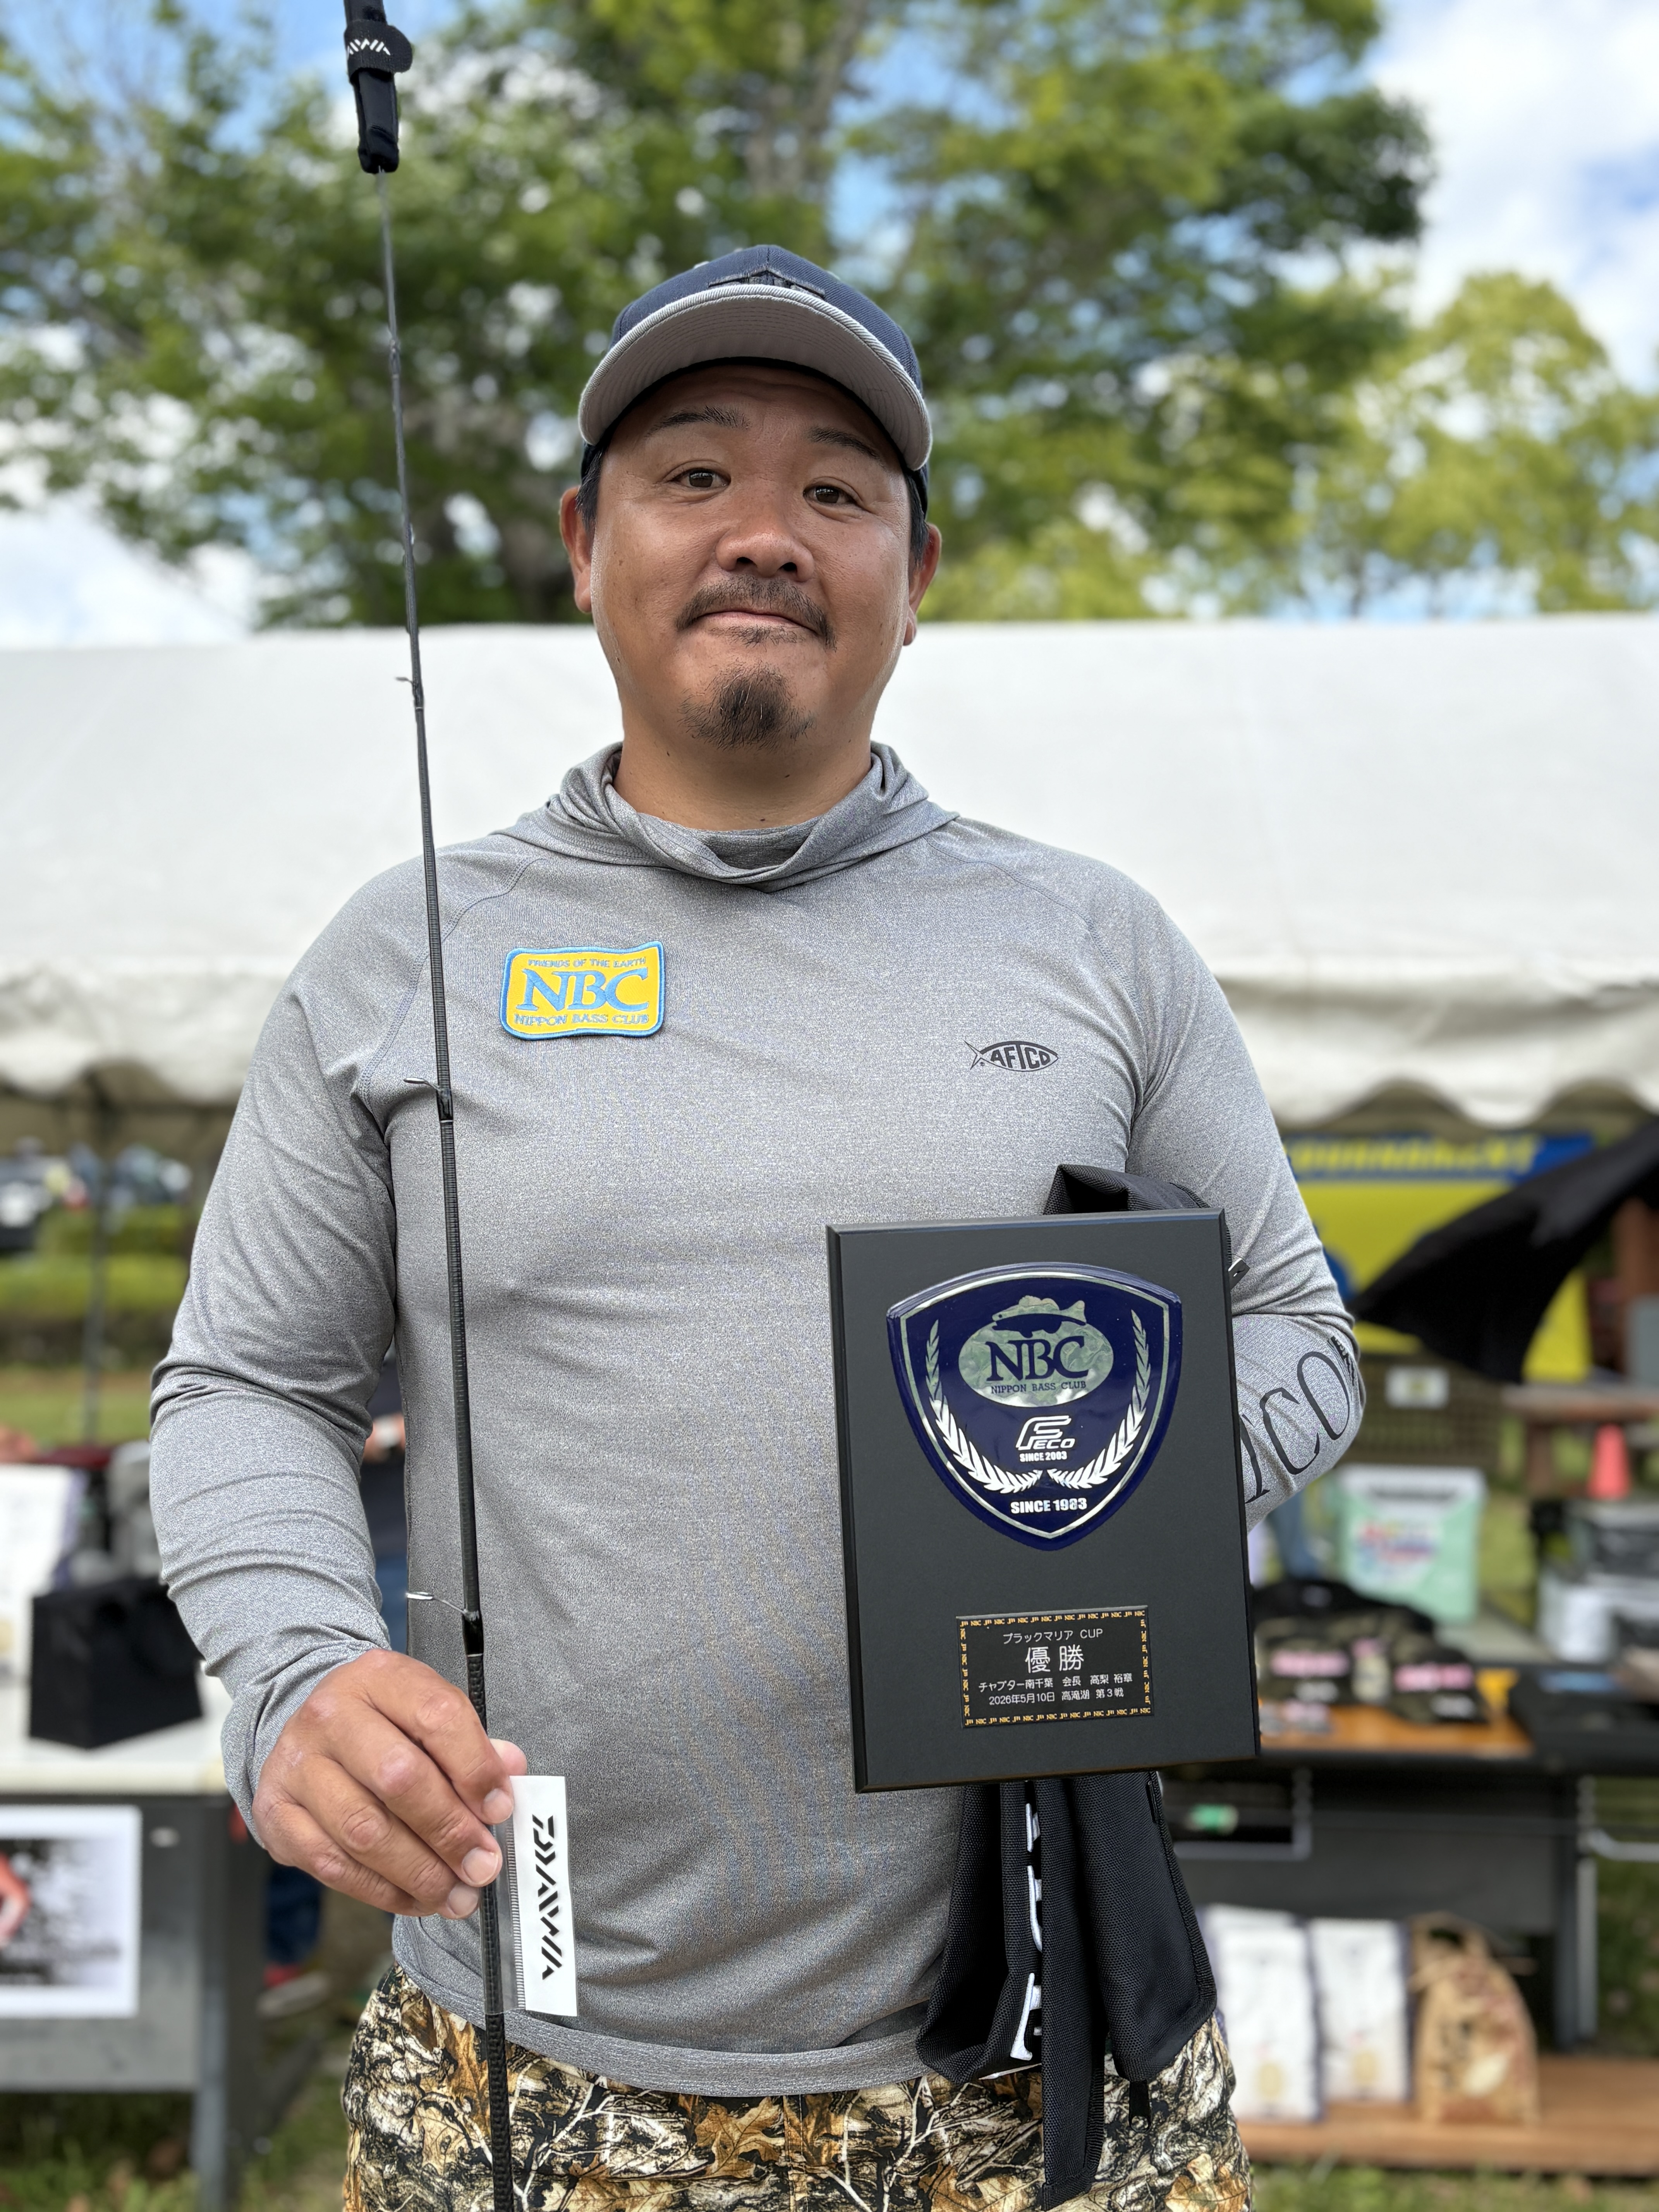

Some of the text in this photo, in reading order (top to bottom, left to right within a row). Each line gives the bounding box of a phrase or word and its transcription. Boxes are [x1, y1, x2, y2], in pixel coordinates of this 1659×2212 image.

[572, 958, 587, 968] OF
[589, 958, 610, 968] THE
[613, 957, 646, 968] EARTH
[516, 968, 649, 1012] NBC
[514, 1013, 649, 1026] NIPPON BASS CLUB
[985, 1336, 1089, 1381] NBC
[991, 1381, 1087, 1394] NIPPON BASS CLUB
[1019, 1451, 1067, 1462] SINCE 2003
[1010, 1497, 1087, 1514] SINCE 1983
[1003, 1628, 1103, 1644] ブラックマリア CUP
[1025, 1644, 1084, 1674] 優勝
[978, 1678, 1054, 1693] チャプター南千葉
[1062, 1675, 1081, 1687] 会長
[1090, 1674, 1109, 1685] 高梨
[989, 1692, 1055, 1705] 2026年5月10日
[531, 1814, 563, 1980] DAIWA
